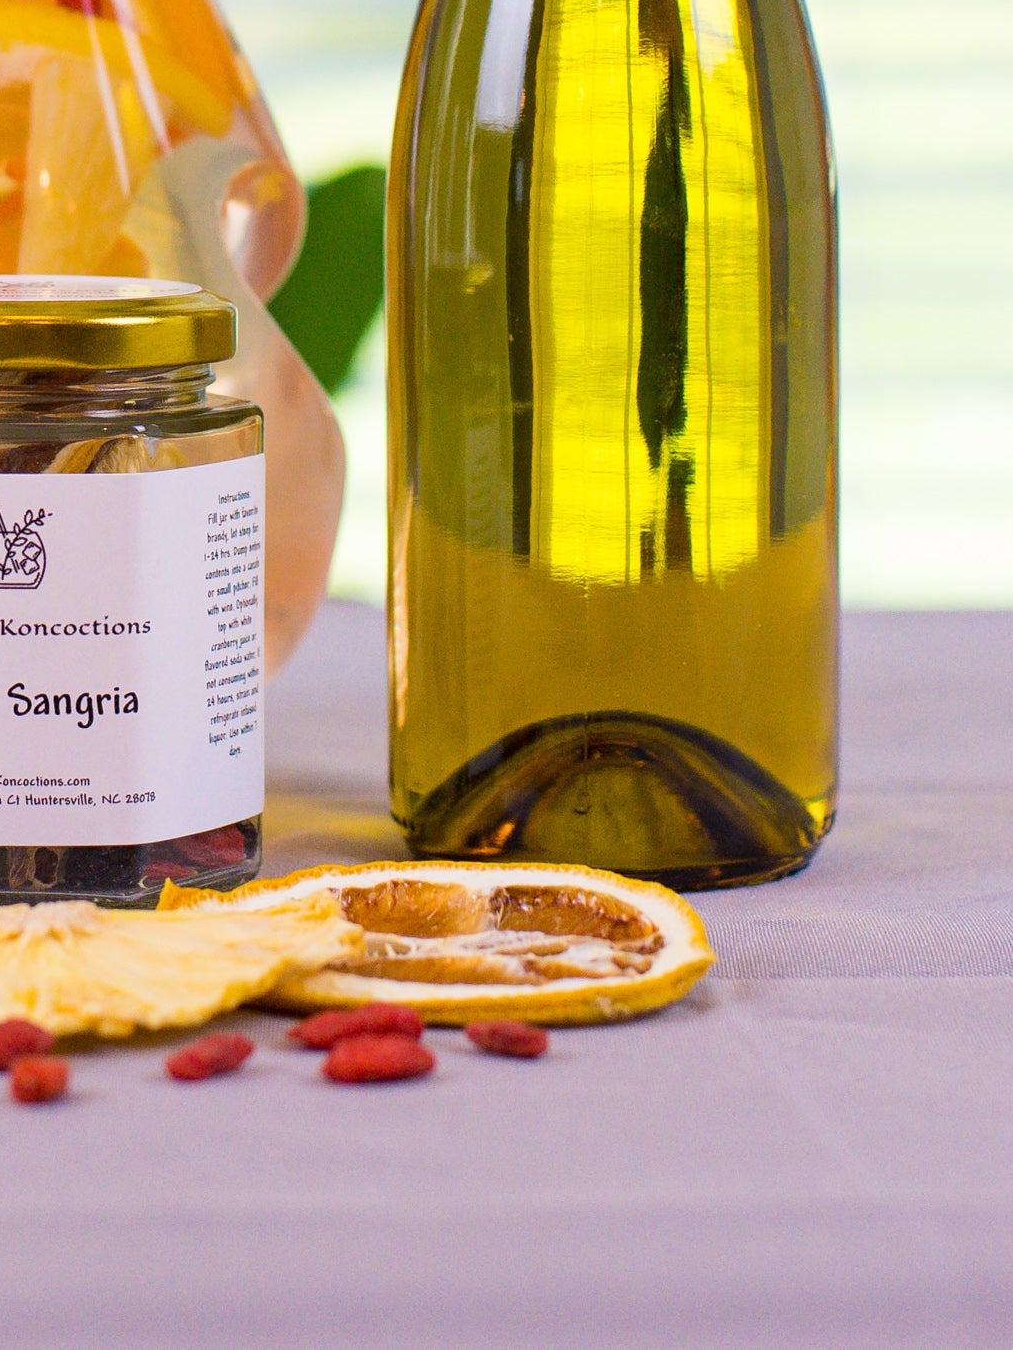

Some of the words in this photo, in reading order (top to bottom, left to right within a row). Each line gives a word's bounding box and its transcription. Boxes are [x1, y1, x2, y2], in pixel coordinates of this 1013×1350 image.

[218, 491, 251, 504] Instructions:
[230, 509, 240, 520] with
[204, 549, 218, 561] 1-24
[233, 546, 247, 556] Dump
[205, 567, 229, 580] contents
[217, 583, 231, 596] small
[207, 604, 219, 615] with
[0, 615, 152, 636] Koncoctions
[229, 618, 239, 628] with
[211, 637, 238, 651] cranberry
[204, 656, 228, 671] flavored
[230, 652, 242, 666] soda
[206, 678, 216, 689] not
[218, 672, 246, 686] consuming
[236, 689, 250, 700] strain
[7, 682, 139, 729] Sangria
[210, 710, 239, 726] refrigerate
[229, 729, 239, 738] Use
[7, 794, 20, 805] Ct
[25, 793, 97, 807] Huntersville,
[102, 794, 121, 805] NC
[126, 792, 156, 804] 28078
